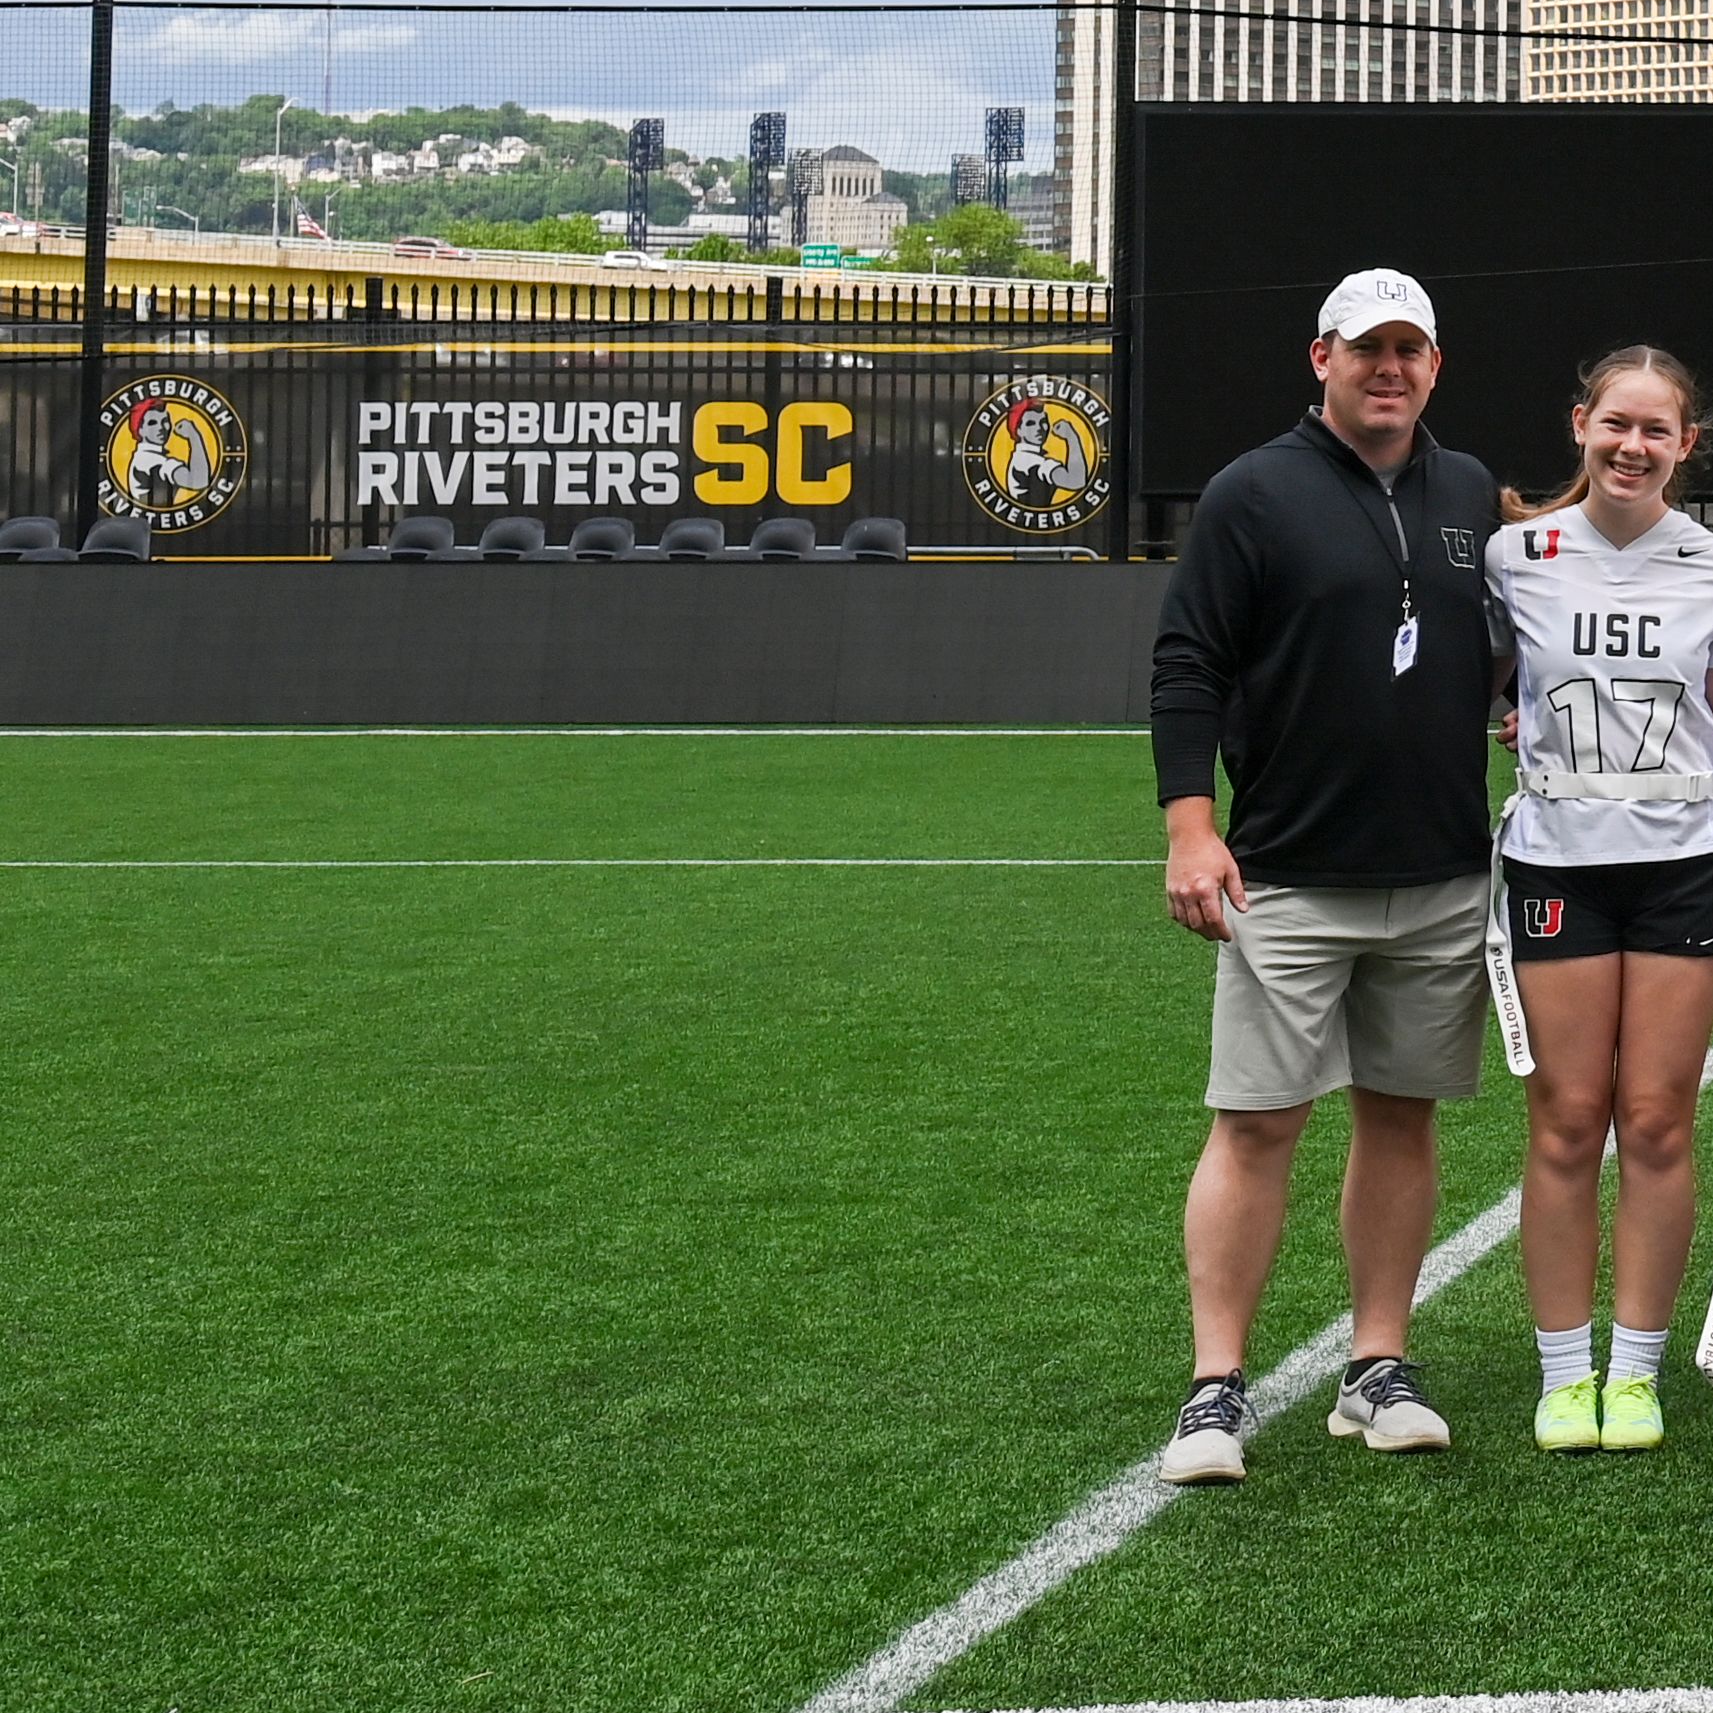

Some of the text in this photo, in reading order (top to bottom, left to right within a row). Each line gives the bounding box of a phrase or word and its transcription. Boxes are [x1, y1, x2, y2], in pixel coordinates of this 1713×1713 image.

[101, 380, 233, 427] PITTSBURGH
[359, 401, 682, 444] PITTSBURGH
[979, 382, 1110, 427] PITTSBURGH
[357, 401, 853, 505] RIVETERS SC
[208, 478, 234, 506] SC
[975, 479, 1110, 528] RIVETERS SC
[1573, 613, 1661, 658] USC
[1547, 678, 1686, 773] 17
